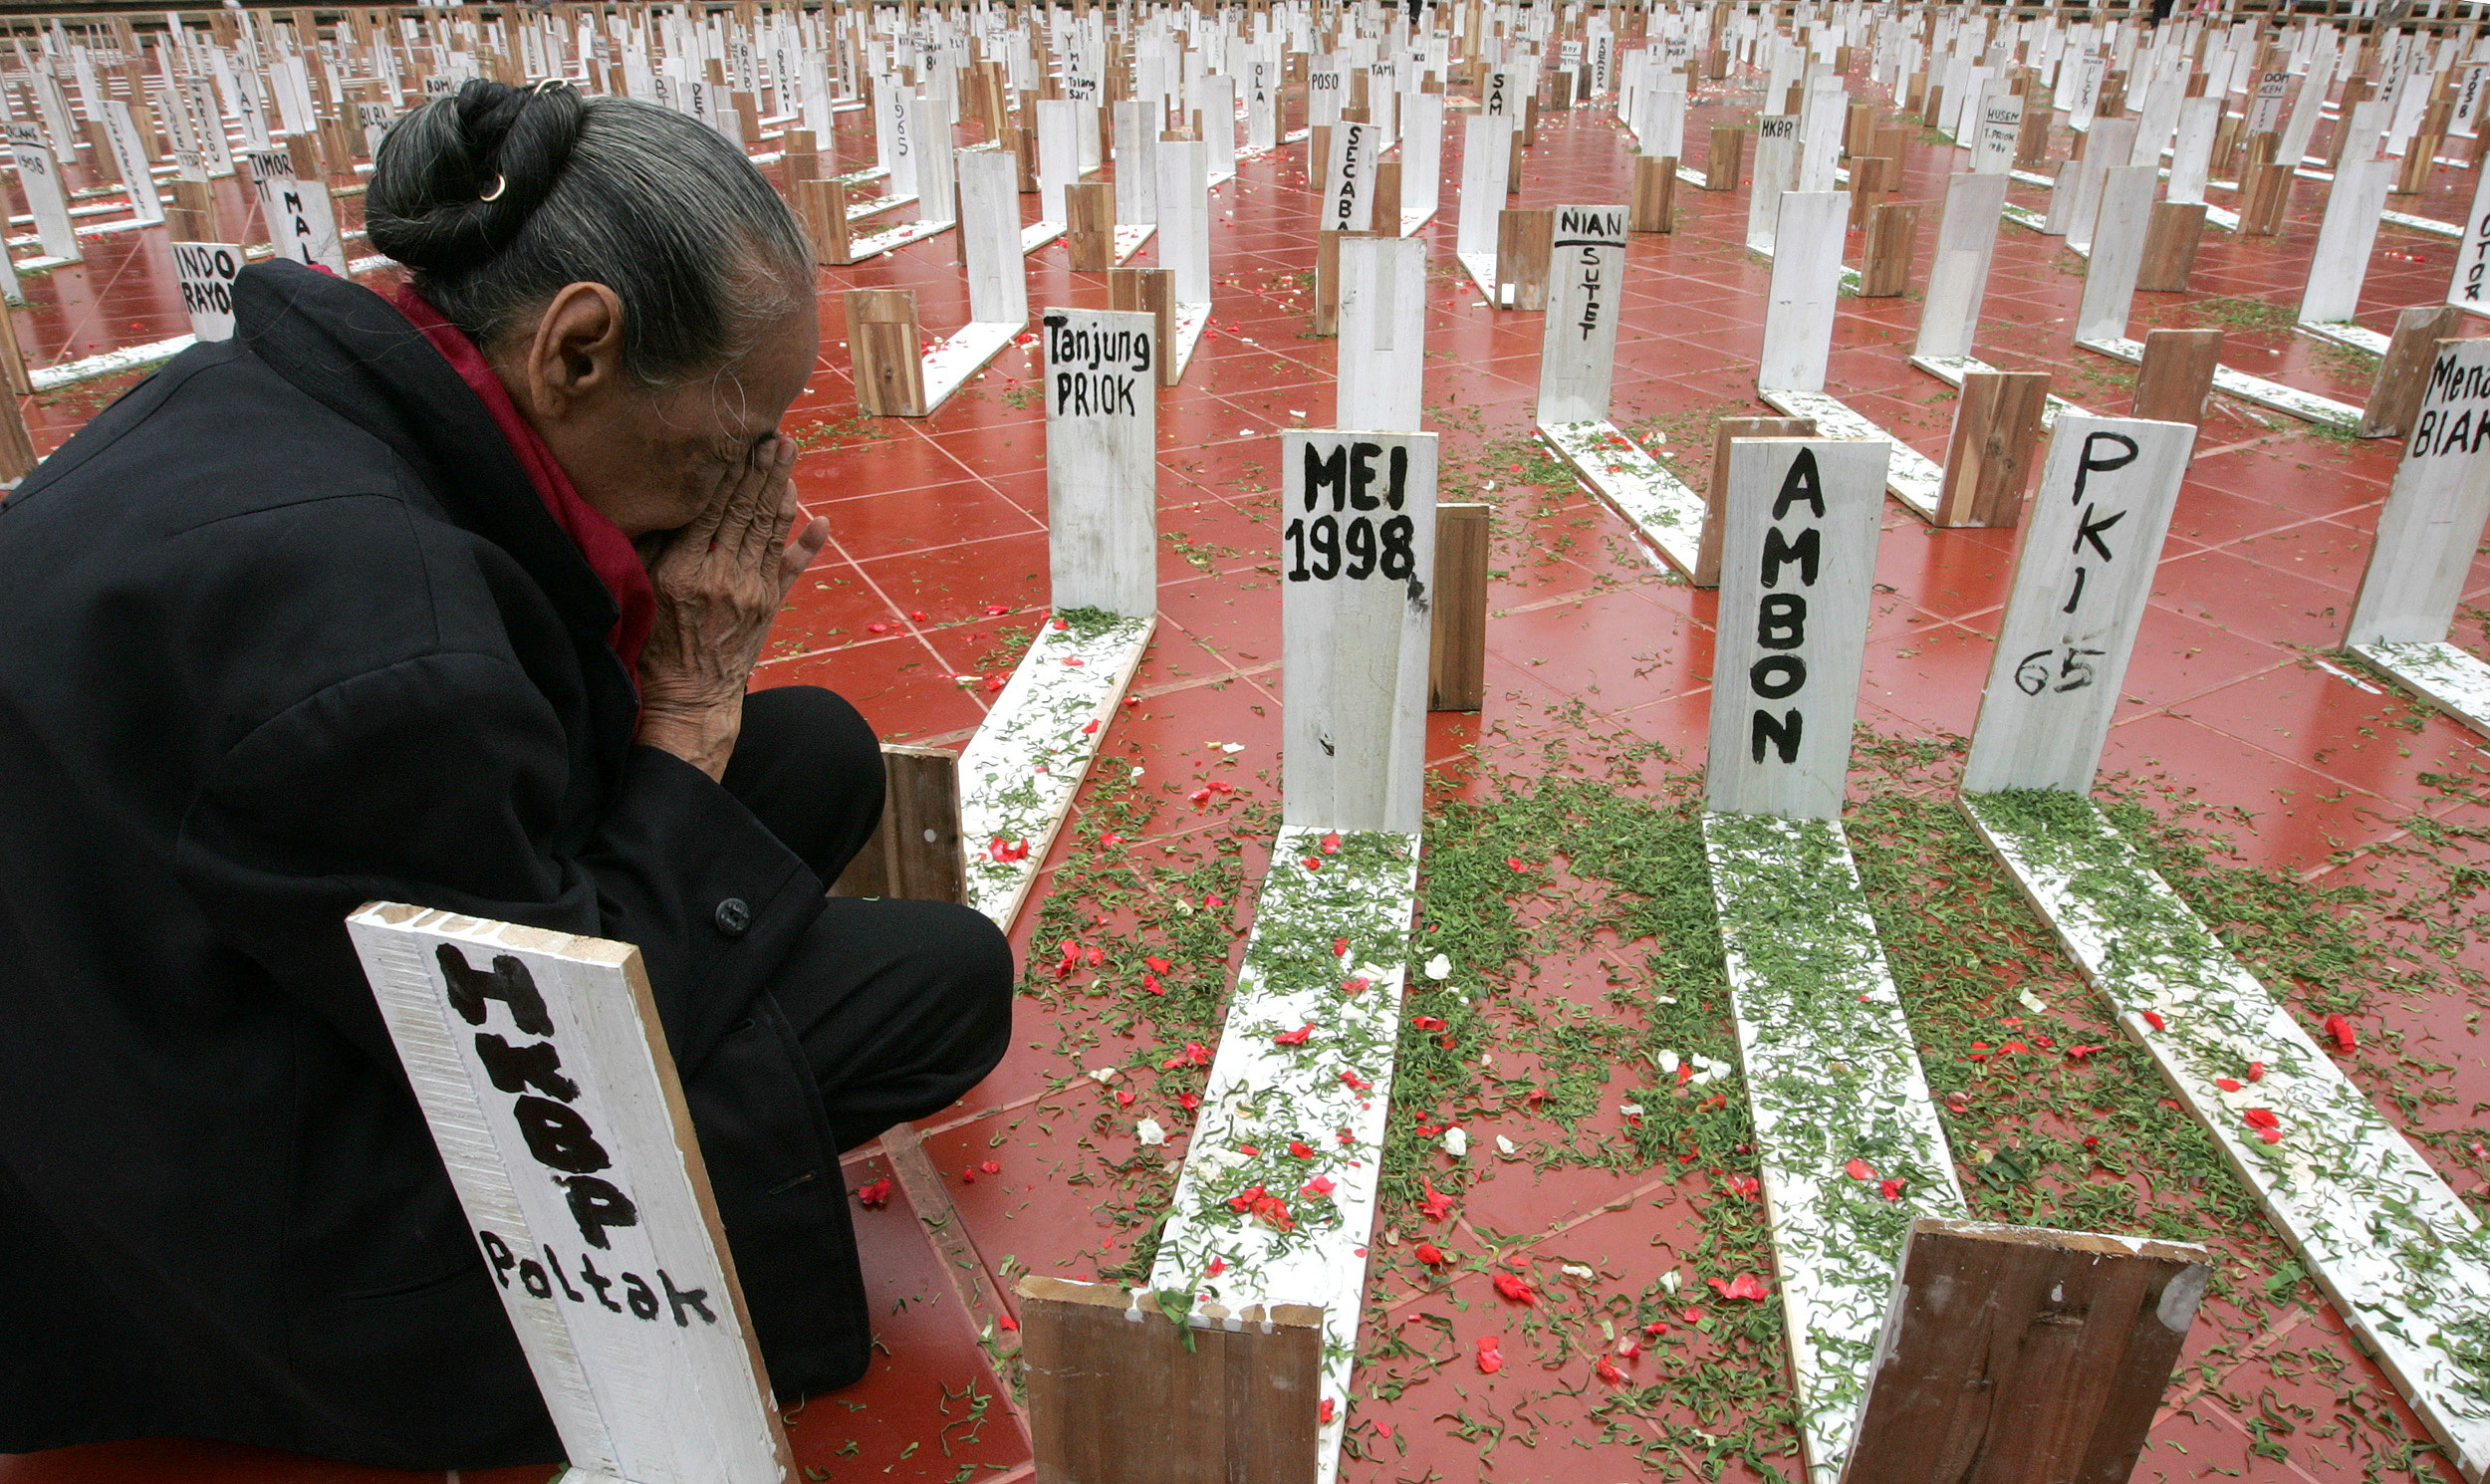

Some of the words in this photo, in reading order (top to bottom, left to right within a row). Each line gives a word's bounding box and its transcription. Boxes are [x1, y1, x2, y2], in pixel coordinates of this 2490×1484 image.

[426, 79, 451, 94] BOM
[1068, 77, 1096, 92] Talang
[1069, 91, 1089, 101] Sari
[1255, 65, 1265, 104] OLA
[1312, 74, 1339, 91] POSO
[893, 91, 909, 156] 1965
[248, 153, 294, 176] TIMOR
[173, 246, 236, 281] INDO
[180, 280, 235, 316] RAYO
[1577, 246, 1603, 342] SUTET
[1044, 316, 1151, 372] Tanjung
[1057, 371, 1136, 417] PRIOK
[1303, 441, 1408, 513] MEI
[1285, 514, 1416, 583] 1998
[2062, 431, 2139, 615] PKI
[1750, 447, 1827, 764] AMBON
[2014, 643, 2109, 697] 65
[435, 942, 640, 1251] HKBP
[479, 1229, 718, 1329] Poltak
